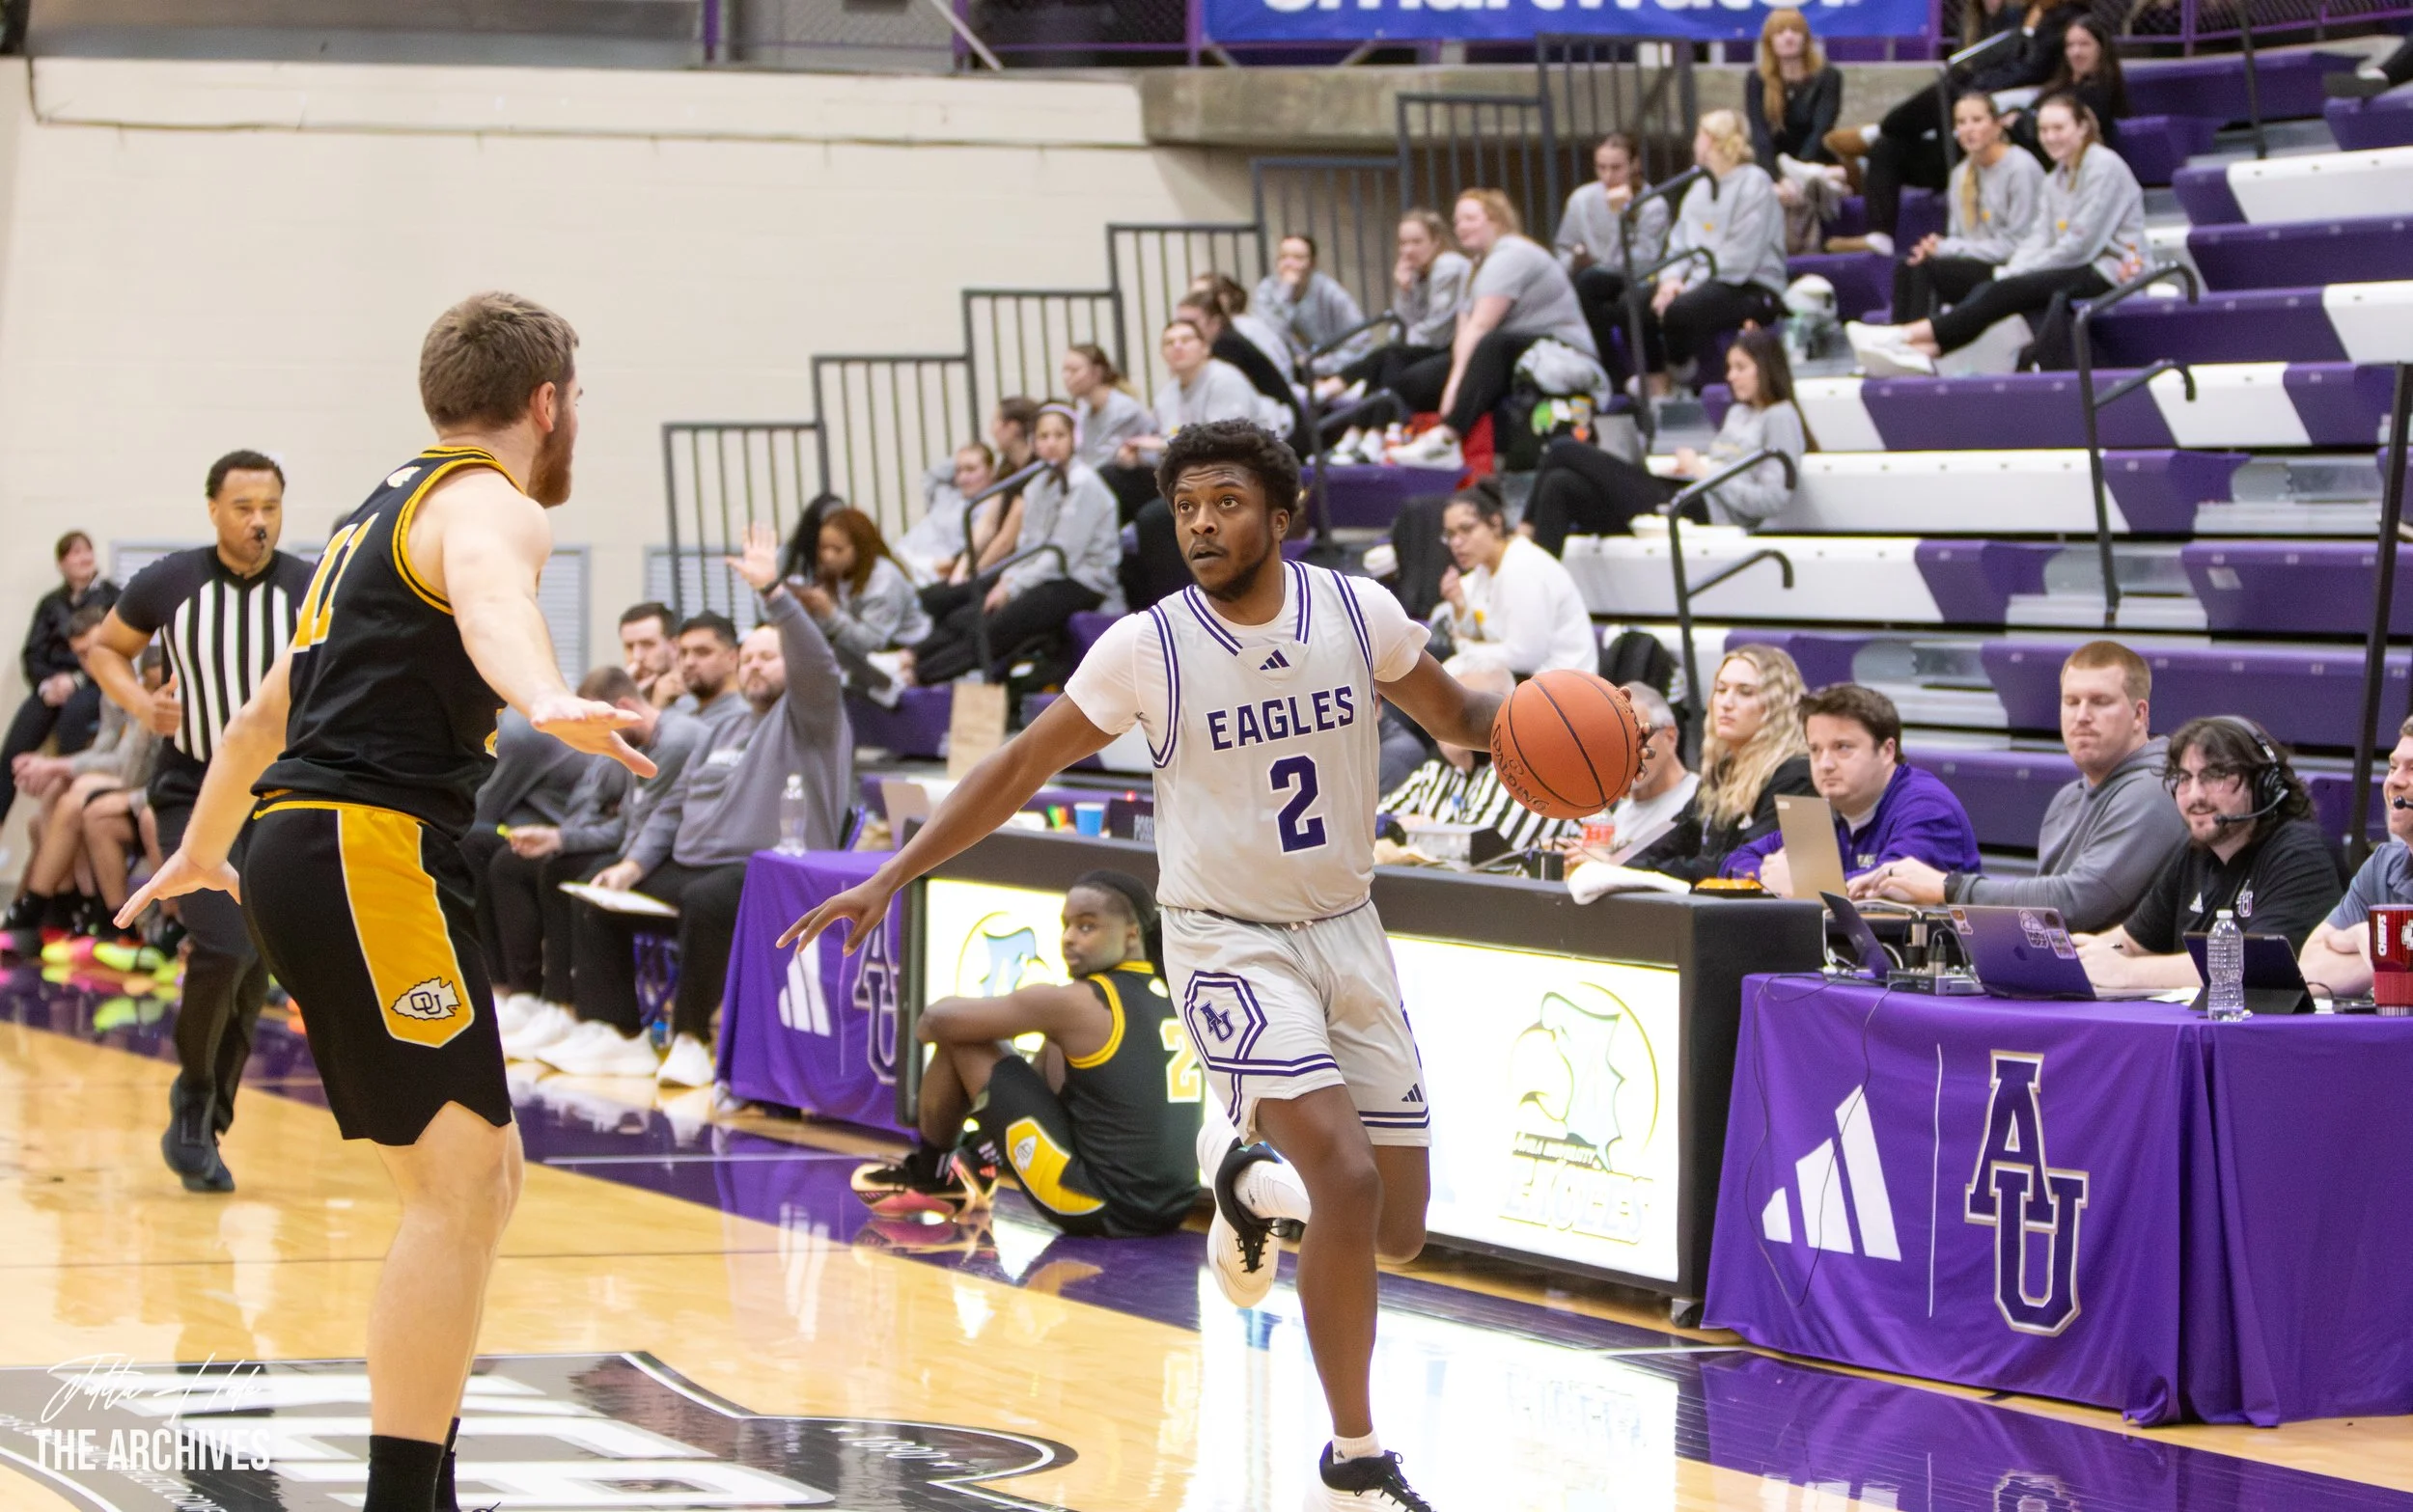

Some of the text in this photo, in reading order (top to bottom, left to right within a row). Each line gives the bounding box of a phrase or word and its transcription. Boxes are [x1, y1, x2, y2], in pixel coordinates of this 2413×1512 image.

[1206, 684, 1354, 752] EAGLES
[1267, 752, 1328, 857] 2
[410, 991, 442, 1016] OU
[1200, 1000, 1235, 1044] AU
[1963, 1048, 2090, 1337] AU
